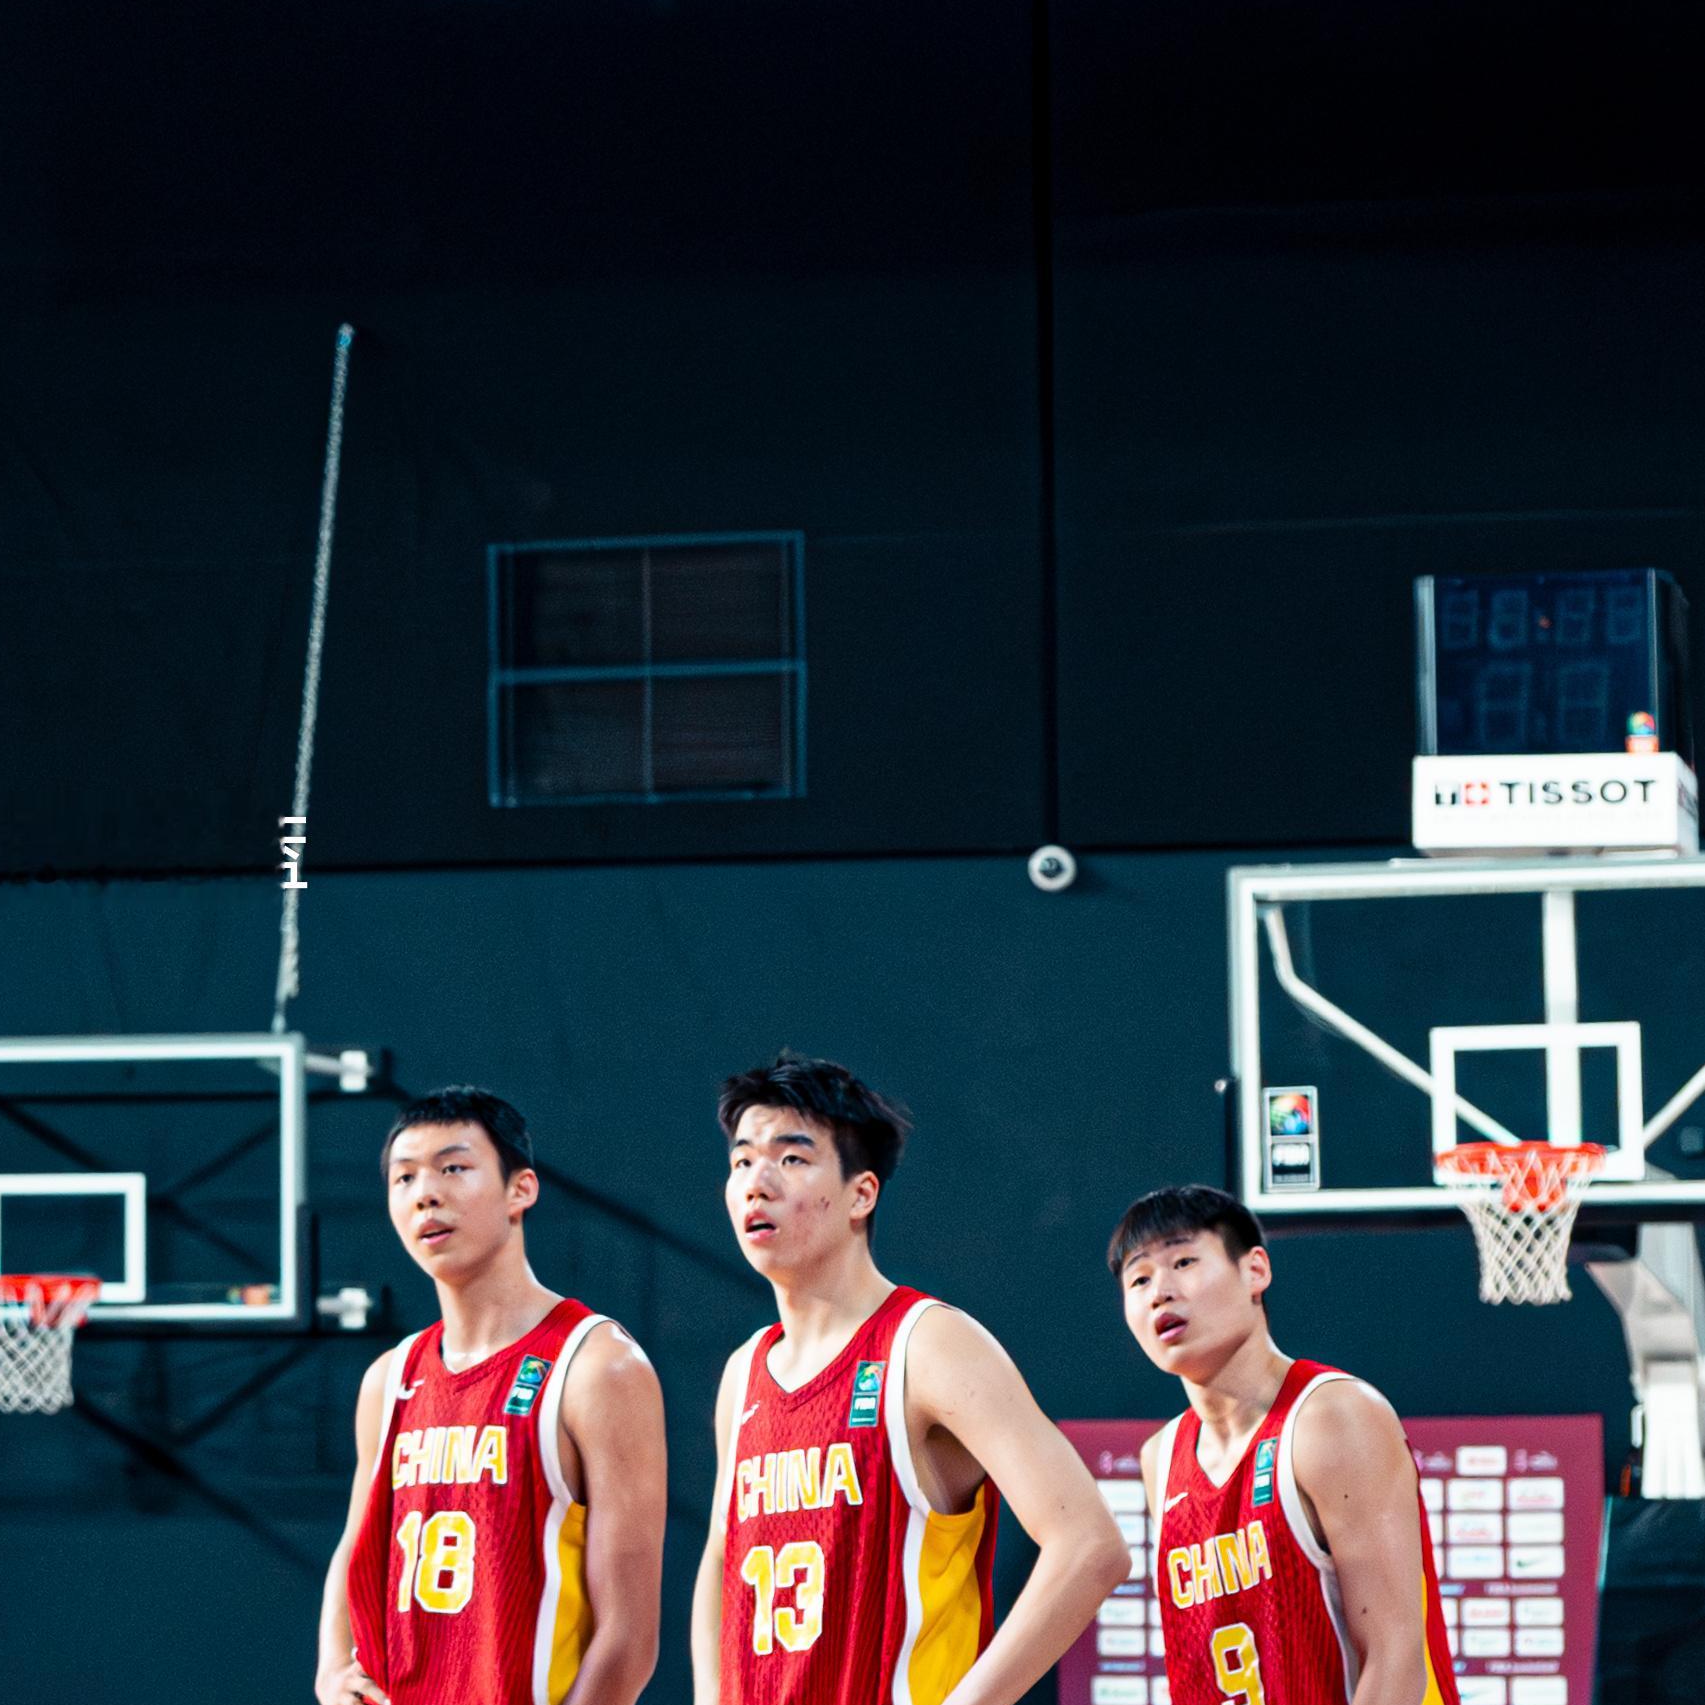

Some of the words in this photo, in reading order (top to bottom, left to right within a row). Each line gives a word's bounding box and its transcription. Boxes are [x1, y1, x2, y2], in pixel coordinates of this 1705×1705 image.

[1499, 779, 1658, 805] TISSOT
[392, 1424, 508, 1491] CHINA
[735, 1441, 864, 1523] CHINA
[395, 1510, 476, 1615] 18
[740, 1540, 826, 1657] 13
[1166, 1519, 1273, 1611] CHINA
